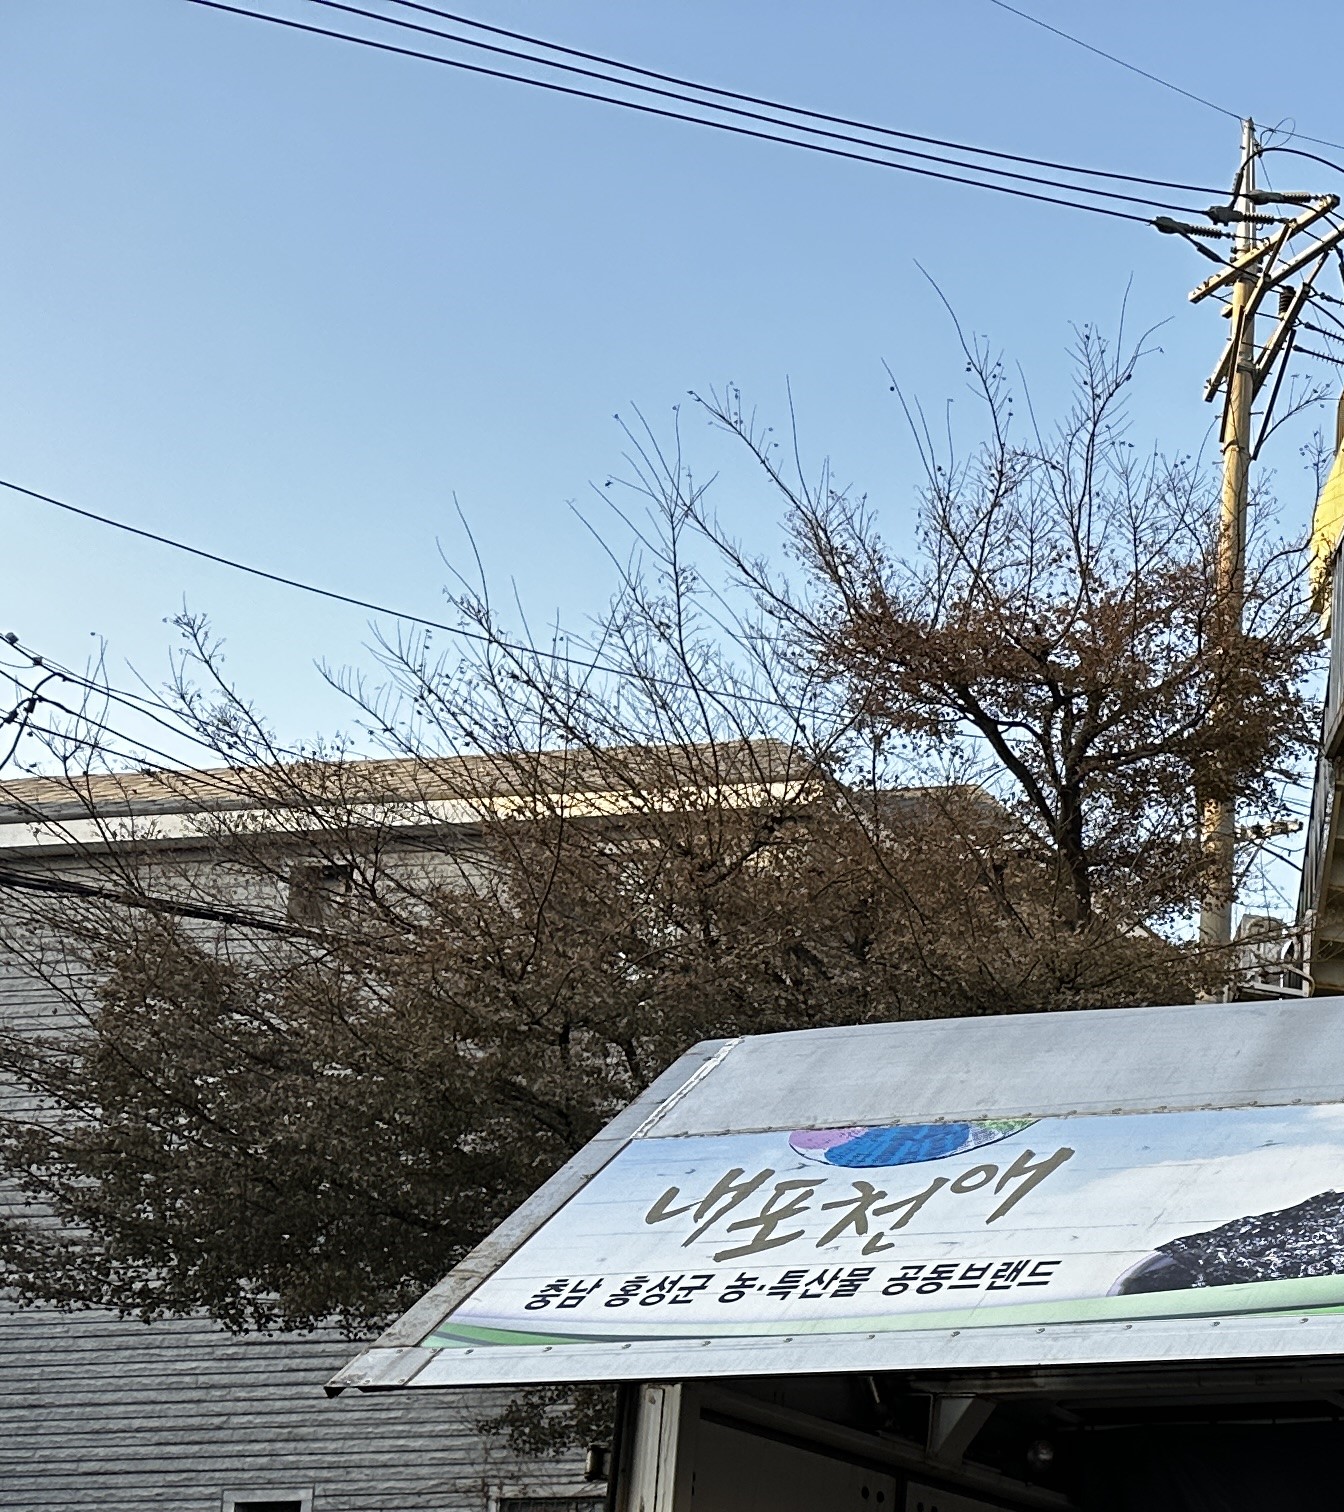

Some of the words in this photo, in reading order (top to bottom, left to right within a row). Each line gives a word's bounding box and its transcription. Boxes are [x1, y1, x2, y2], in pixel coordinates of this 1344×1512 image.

[645, 1147, 1076, 1263] 내포천애
[525, 1278, 602, 1311] 충남
[604, 1272, 713, 1307] 홍성군
[717, 1265, 872, 1304] 농·특산물
[883, 1259, 1062, 1295] 공동브랜드
